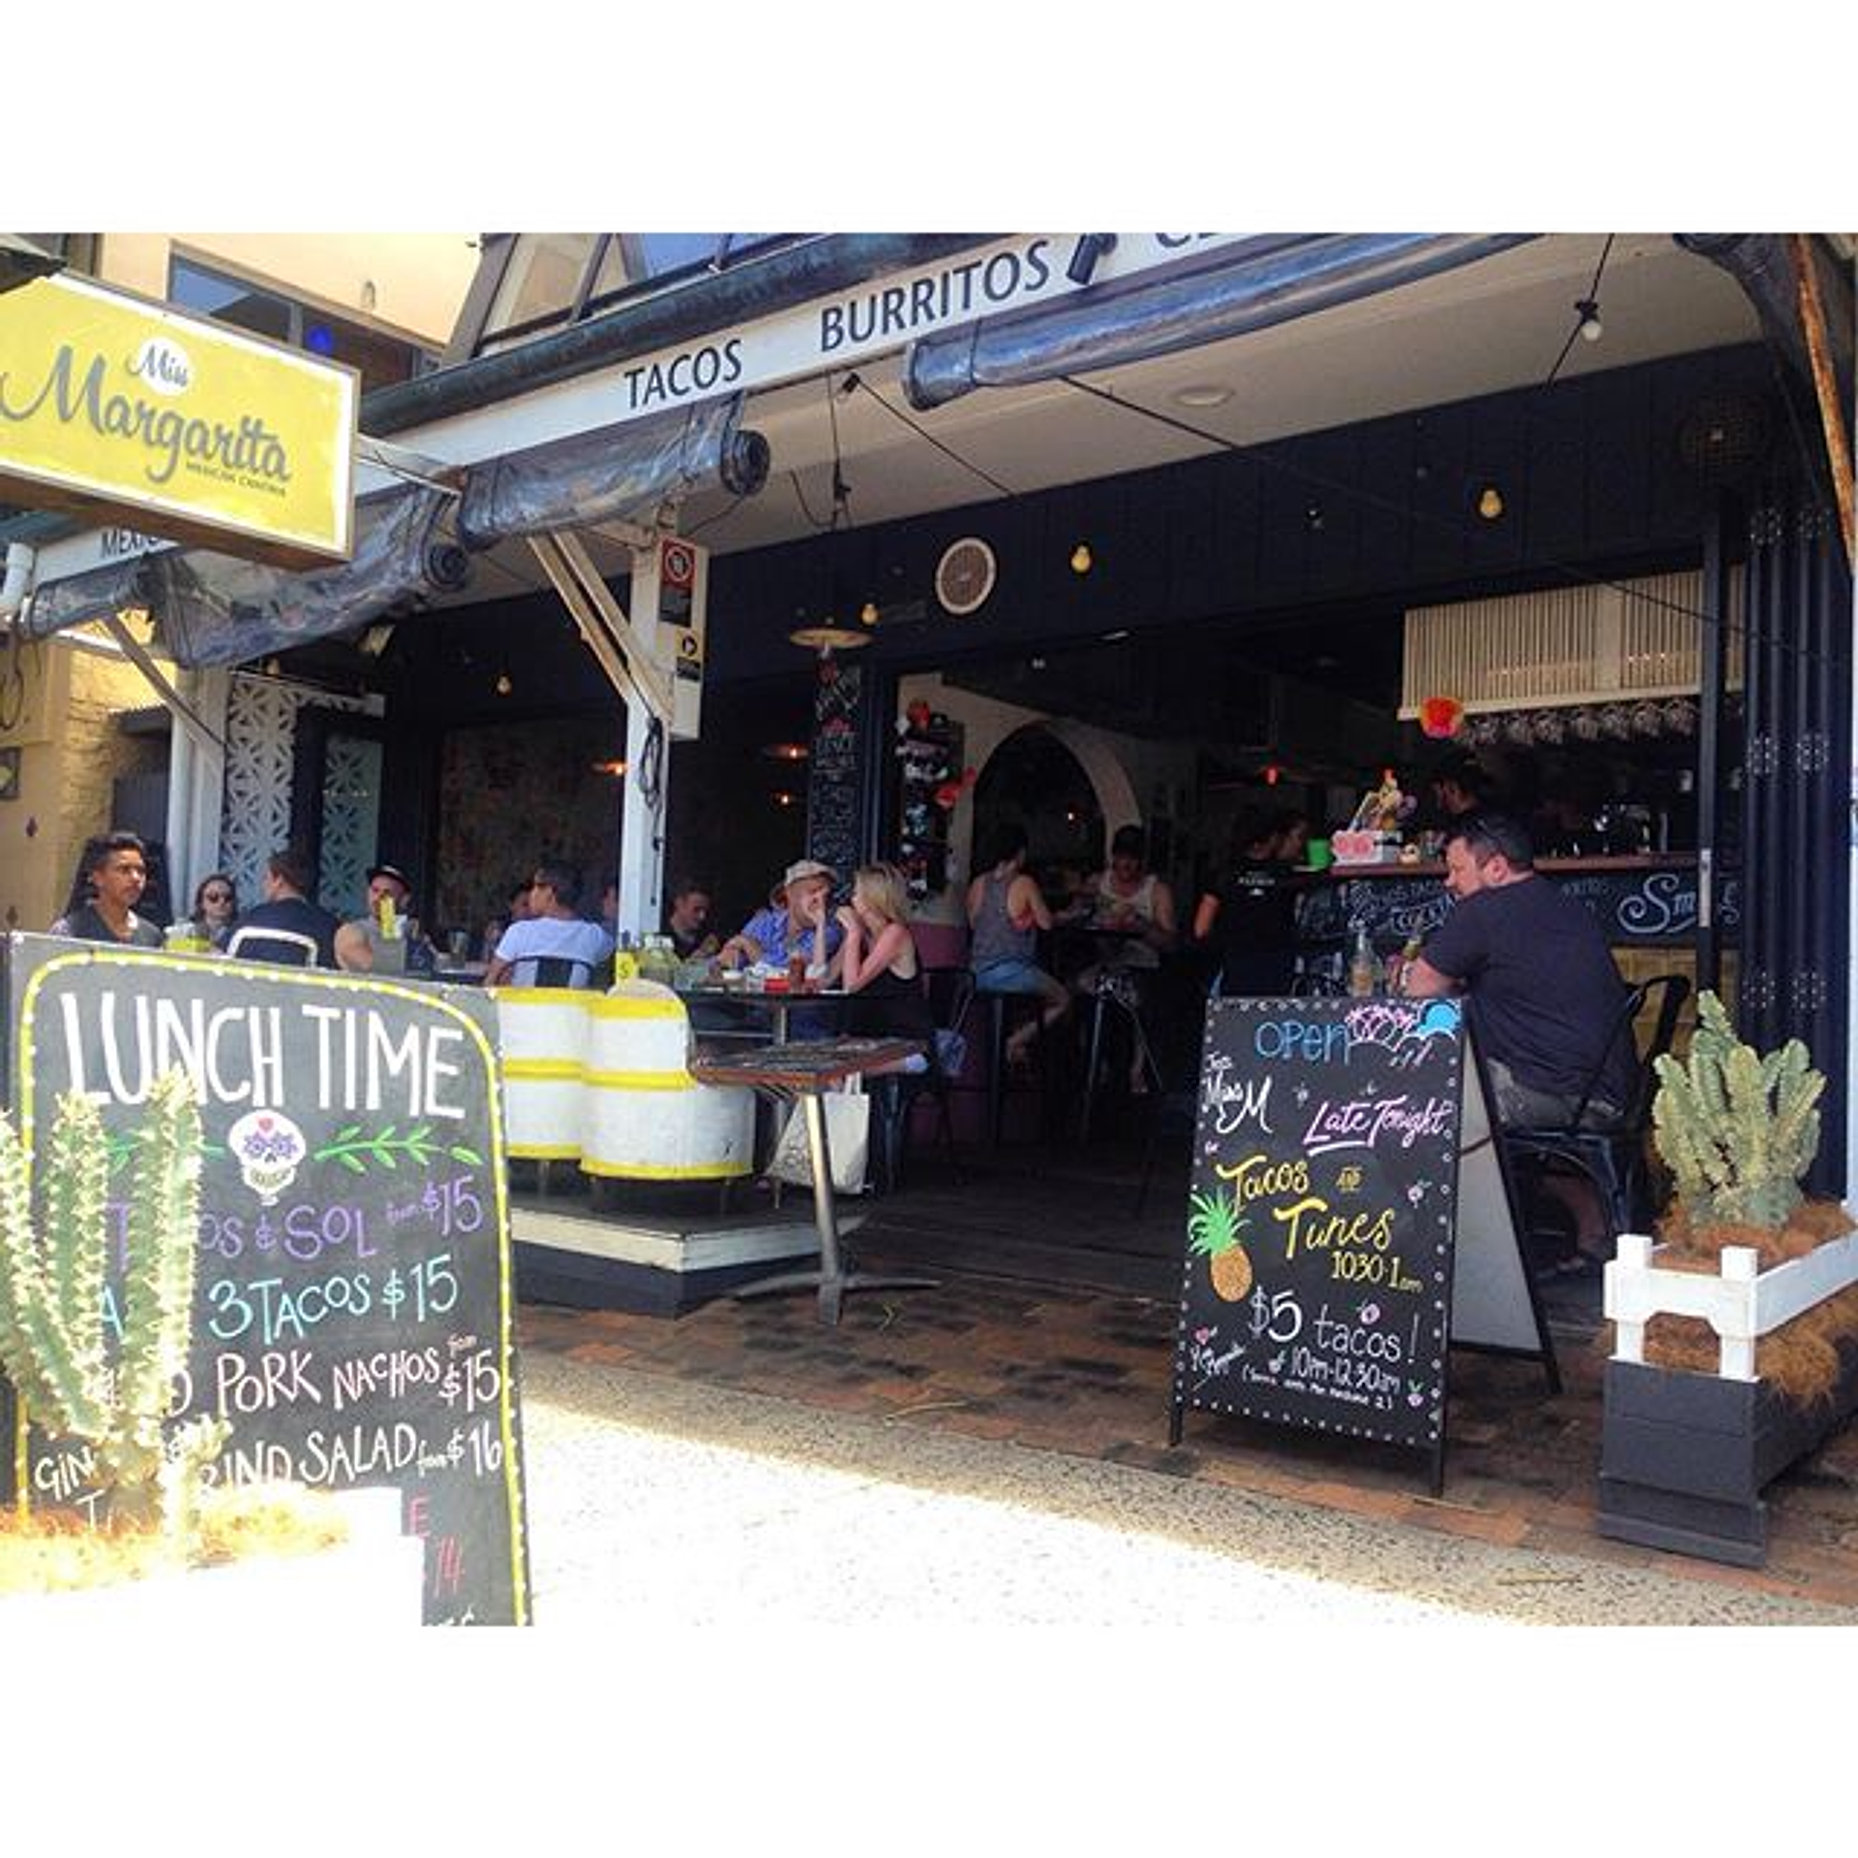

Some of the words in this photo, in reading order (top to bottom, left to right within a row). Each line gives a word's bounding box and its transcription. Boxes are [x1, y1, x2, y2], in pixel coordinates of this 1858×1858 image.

[623, 338, 743, 411] TACOS
[819, 238, 1051, 353] BURRITOS
[125, 344, 188, 388] Miss
[0, 345, 292, 484] Margarita
[59, 991, 284, 1108] LUNCH
[302, 1003, 466, 1119] TIME
[1303, 1101, 1372, 1146] Late
[1216, 1154, 1310, 1218] Tacos
[106, 1201, 244, 1274] TOS
[284, 1205, 378, 1261] SOL
[421, 1174, 484, 1237] $15
[1272, 1197, 1396, 1260] Tunes
[382, 1254, 459, 1322] $15
[1248, 1284, 1302, 1343] $5
[215, 1349, 321, 1418] PORK
[332, 1345, 441, 1411] NACHOS
[438, 1348, 502, 1413] $15
[298, 1422, 418, 1487] SALAD
[446, 1419, 504, 1478] $16
